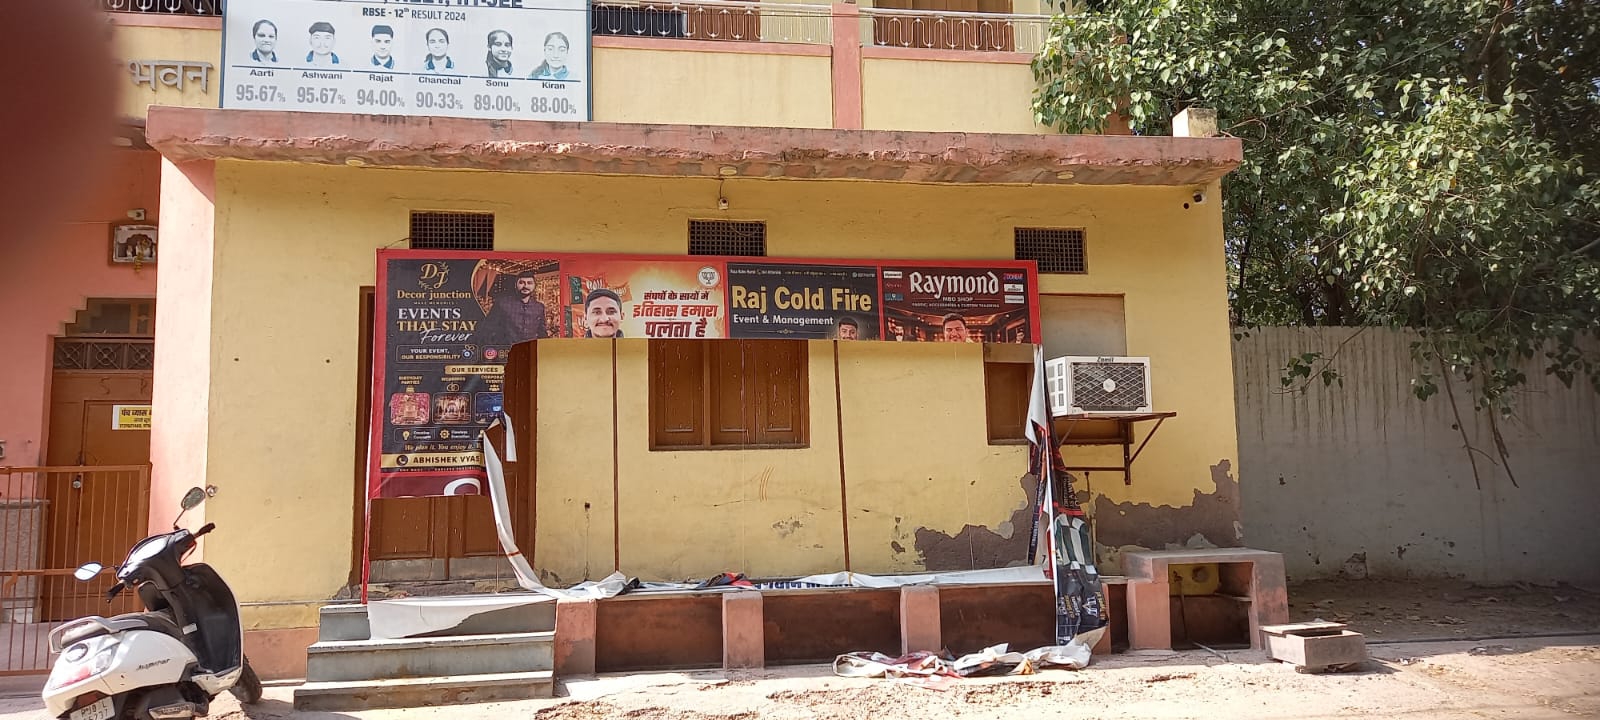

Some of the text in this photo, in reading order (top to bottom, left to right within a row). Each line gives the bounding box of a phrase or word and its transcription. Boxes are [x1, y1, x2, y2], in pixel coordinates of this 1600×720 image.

[362, 7, 386, 17] RBSE
[394, 7, 410, 18] 12th
[411, 10, 442, 20] RESULT
[444, 11, 466, 21] 2024
[128, 59, 214, 95] भवन
[249, 69, 274, 78] Aarti
[301, 71, 343, 80] Ashwani
[369, 73, 394, 83] Rajat
[418, 76, 462, 86] Chanchal
[486, 79, 509, 88] Sonu
[541, 81, 566, 91] Kiran
[236, 84, 286, 103] 95.67%
[297, 86, 346, 105] 95.67%
[357, 89, 405, 107] 94.00%
[416, 91, 464, 110] 90.33%
[474, 94, 521, 112] 89.00%
[531, 96, 577, 114] 88.00%
[909, 270, 999, 299] Raymond
[397, 289, 472, 301] Decor junction
[731, 285, 872, 314] Raj Cold Fire
[398, 308, 461, 320] EVENTS
[633, 301, 719, 318] इतिहास हमारा
[397, 320, 477, 332] THAT STAY
[645, 317, 708, 338] पलता है
[733, 314, 834, 326] Event & Management
[420, 328, 473, 345] Forever
[413, 455, 480, 465] ABHISHEK VYAS
